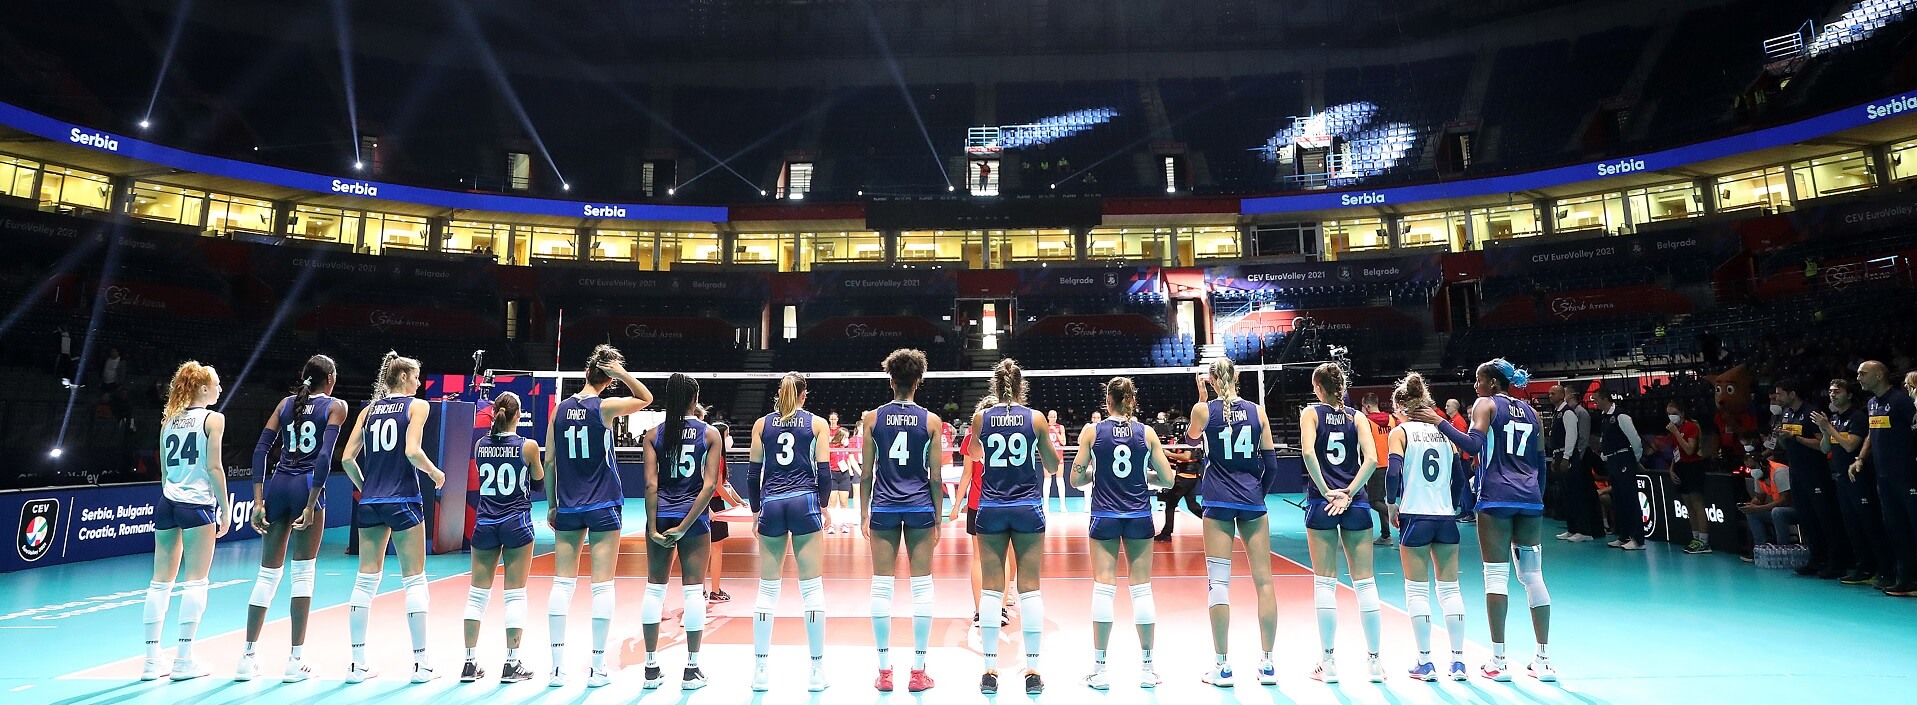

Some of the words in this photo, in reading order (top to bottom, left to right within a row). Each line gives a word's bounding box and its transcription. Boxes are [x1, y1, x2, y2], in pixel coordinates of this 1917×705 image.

[1867, 96, 1917, 119] Serbia
[70, 128, 118, 151] Serbia
[1598, 159, 1645, 175] Serbia
[332, 180, 378, 196] Serbia
[1342, 192, 1385, 205] Serbia
[583, 205, 626, 217] Serbia
[1845, 213, 1864, 224] CEV
[1866, 206, 1912, 220] EuroVolley
[5, 219, 55, 236] EuroVolley
[57, 227, 78, 238] 2021
[119, 236, 156, 250] Belgrade
[1656, 238, 1697, 250] Belgrade
[1532, 253, 1549, 263] CEV
[1551, 249, 1594, 262] EuroVolley
[1596, 247, 1615, 257] 2021
[292, 257, 310, 267] CEV
[312, 260, 355, 272] EuroVolley
[358, 264, 376, 273] 2021
[1363, 266, 1400, 277] Belgrade
[415, 268, 450, 279] Belgrade
[1060, 277, 1094, 286] Belgrade
[1247, 273, 1264, 282] CEV
[1265, 272, 1307, 283] EuroVolley
[1308, 271, 1326, 280] 2021
[578, 278, 595, 286] CEV
[597, 278, 637, 288] EuroVolley
[692, 281, 727, 289] Belgrade
[845, 279, 860, 287] CEV
[862, 279, 902, 289] EuroVolley
[903, 279, 920, 287] 2021
[566, 408, 587, 420] DANESI
[886, 414, 918, 426] BONIFACIO
[286, 420, 317, 454] 18
[370, 418, 398, 453] 10
[1112, 426, 1130, 437] ORRO
[1503, 420, 1533, 457] 17
[165, 431, 199, 467] 24
[564, 425, 590, 459] 11
[776, 431, 795, 466] 3
[889, 431, 910, 466] 4
[987, 432, 1028, 468] 29
[1218, 425, 1254, 460] 14
[1326, 431, 1347, 466] 5
[478, 446, 520, 458] PARROCCHIALE
[1112, 444, 1132, 479] 8
[1422, 448, 1440, 483] 6
[479, 462, 517, 496] 20
[1636, 479, 1646, 489] EV
[32, 503, 50, 514] CEV
[81, 506, 115, 521] Serbia,
[117, 503, 154, 520] Bulgaria
[78, 525, 117, 540] Croatia,
